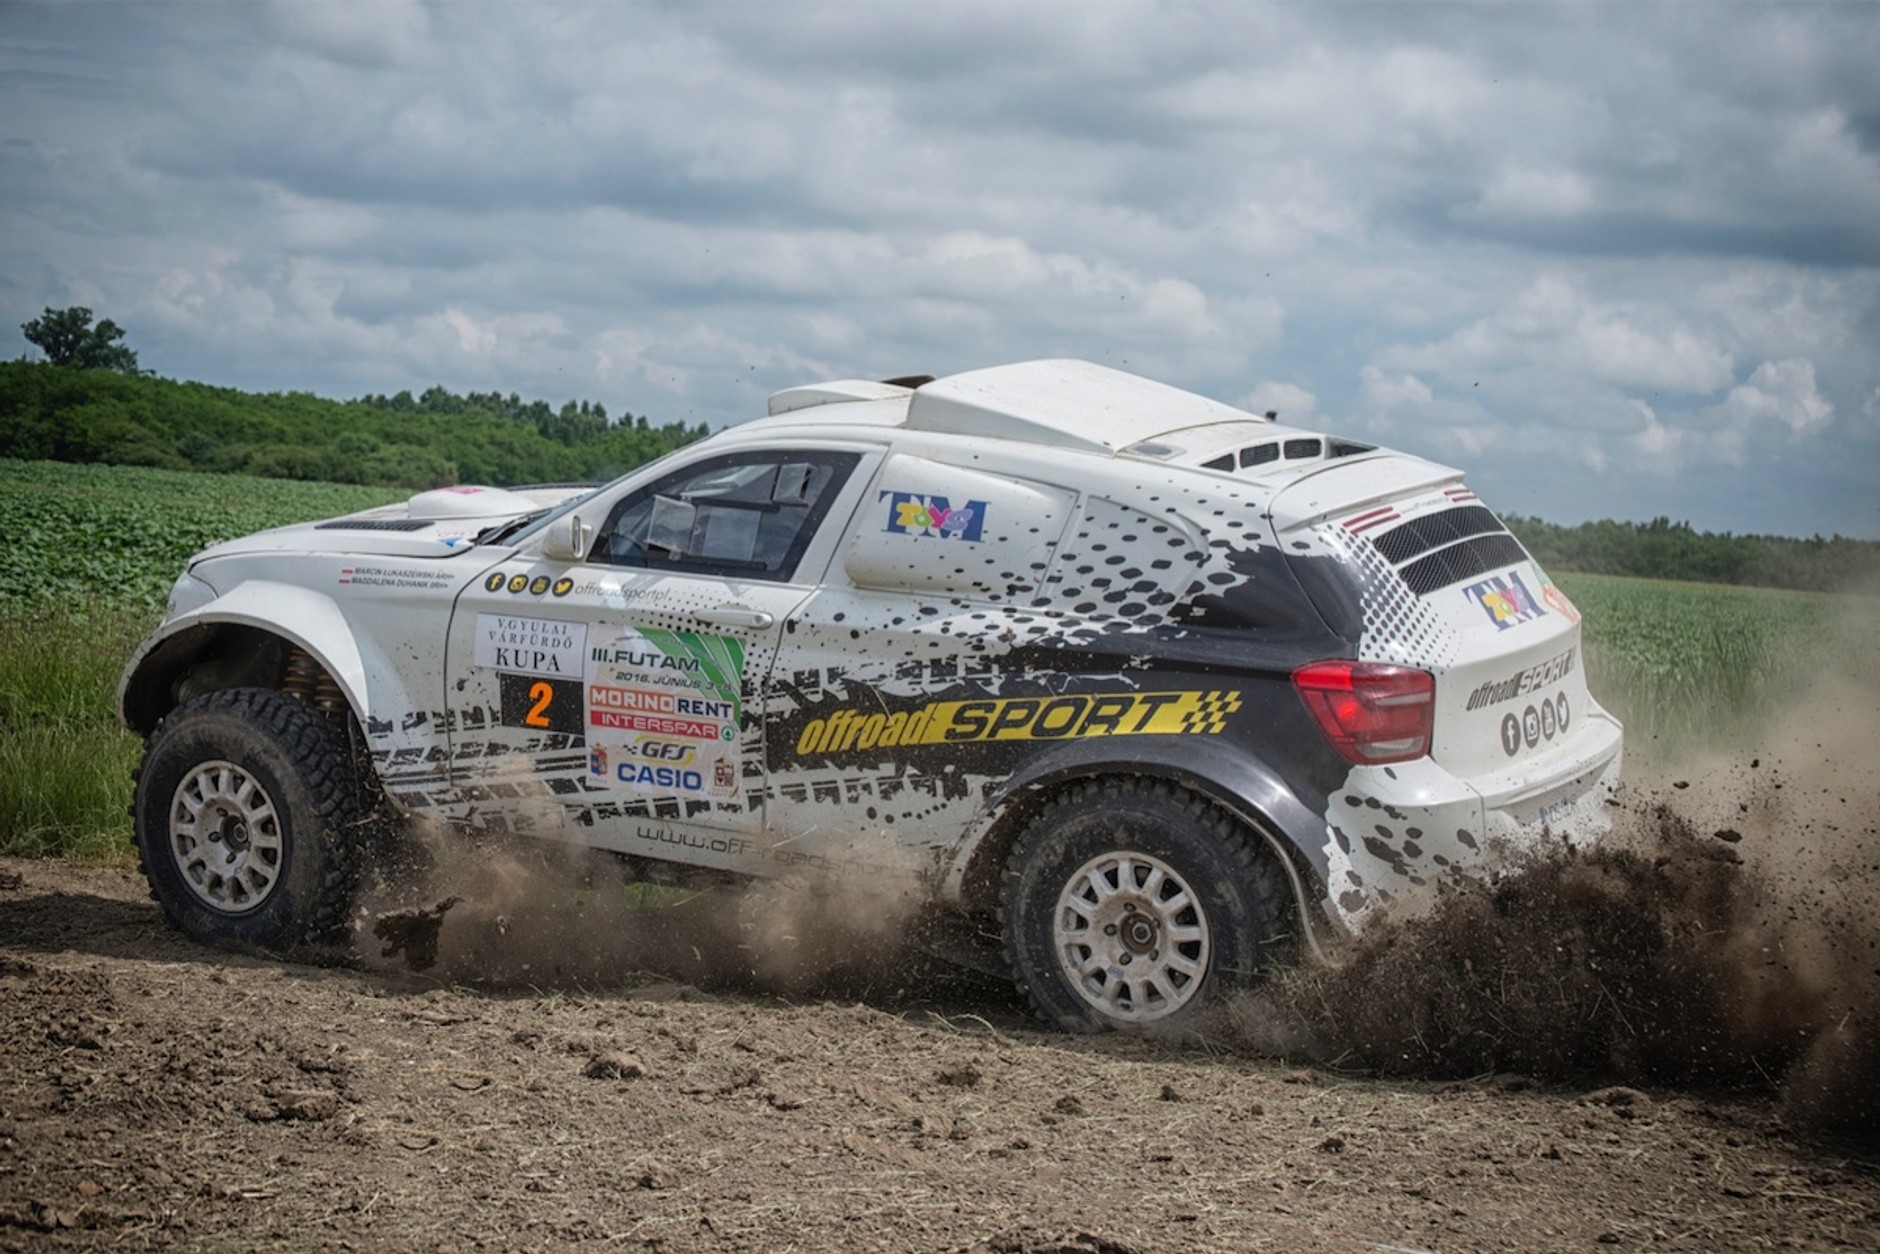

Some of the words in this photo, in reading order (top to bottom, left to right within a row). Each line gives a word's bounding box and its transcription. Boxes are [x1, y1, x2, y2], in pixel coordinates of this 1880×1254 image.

[496, 647, 561, 672] KUPA
[616, 671, 650, 683] 2016.
[526, 682, 553, 727] 2
[601, 713, 717, 737] INTERSPAR
[641, 741, 696, 760] GFS
[617, 763, 702, 790] CASIO
